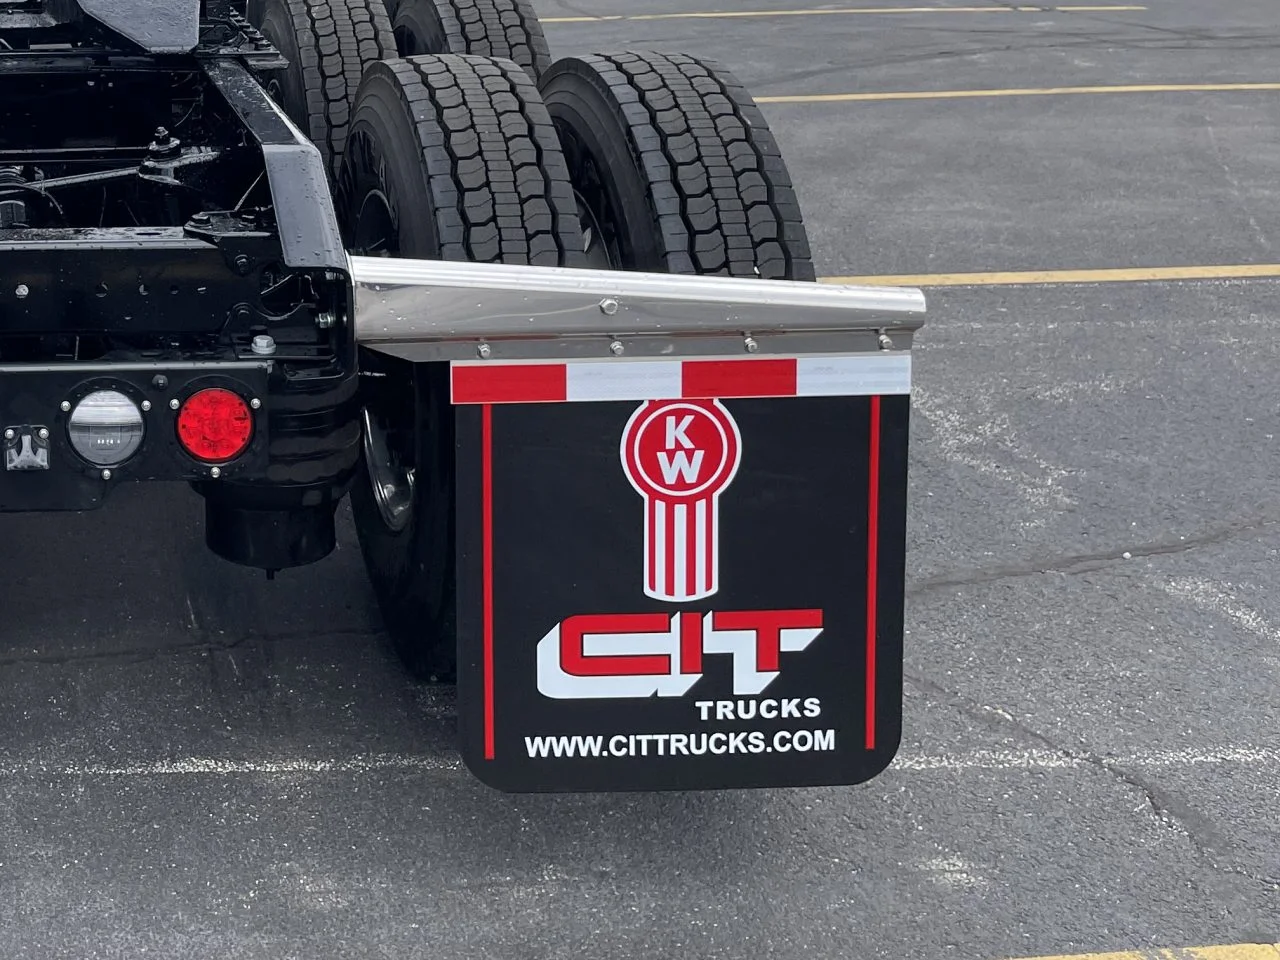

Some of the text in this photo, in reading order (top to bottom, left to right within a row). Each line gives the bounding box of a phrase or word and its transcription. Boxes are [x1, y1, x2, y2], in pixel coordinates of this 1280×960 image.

[536, 608, 824, 699] CIT
[695, 697, 821, 721] TRUCKS
[524, 729, 836, 758] WWW.CITTRUCKS.COM
